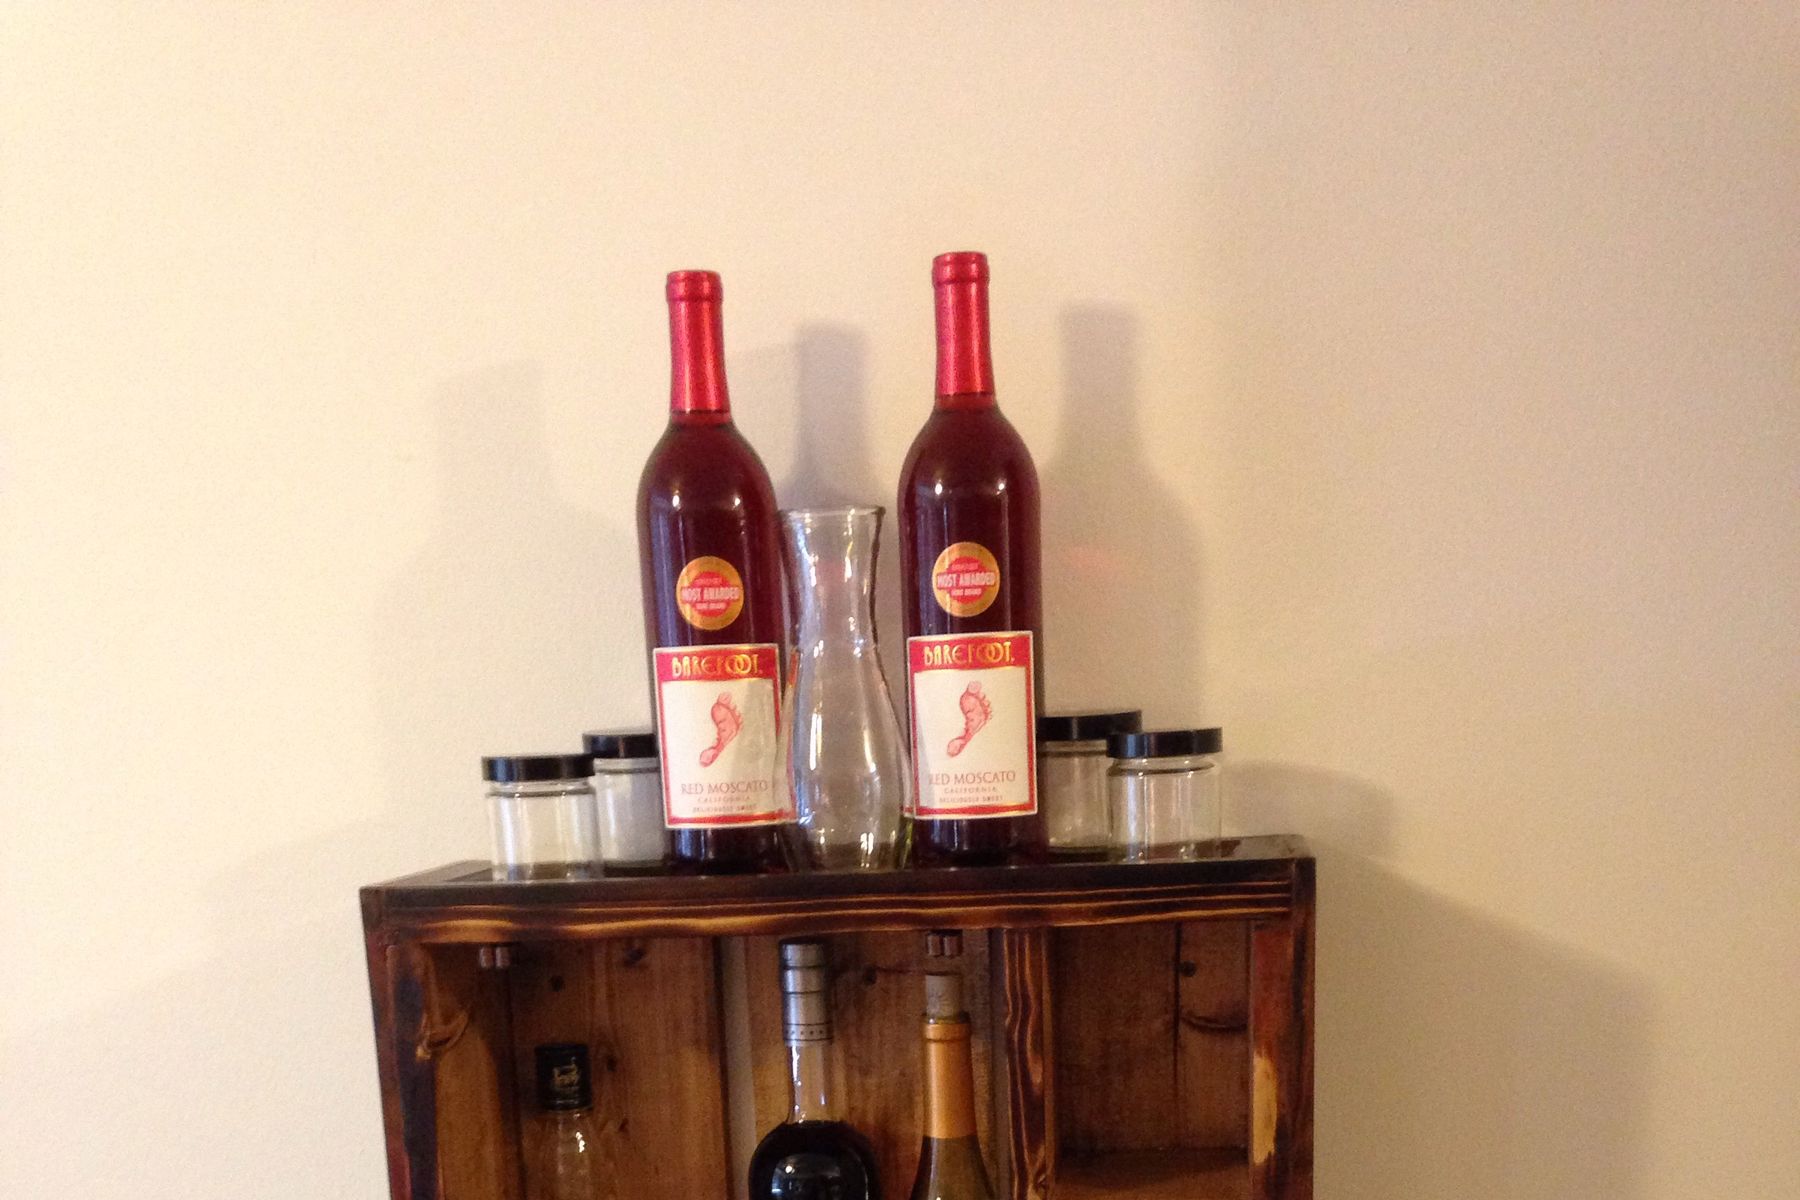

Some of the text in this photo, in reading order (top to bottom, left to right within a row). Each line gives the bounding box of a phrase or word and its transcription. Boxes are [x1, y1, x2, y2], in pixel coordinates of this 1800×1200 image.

[923, 641, 1012, 666] BAREFOOT
[671, 653, 759, 678] BAREFOOT
[680, 780, 768, 795] RED MOSCATO
[953, 770, 1016, 785] MOSCATO
